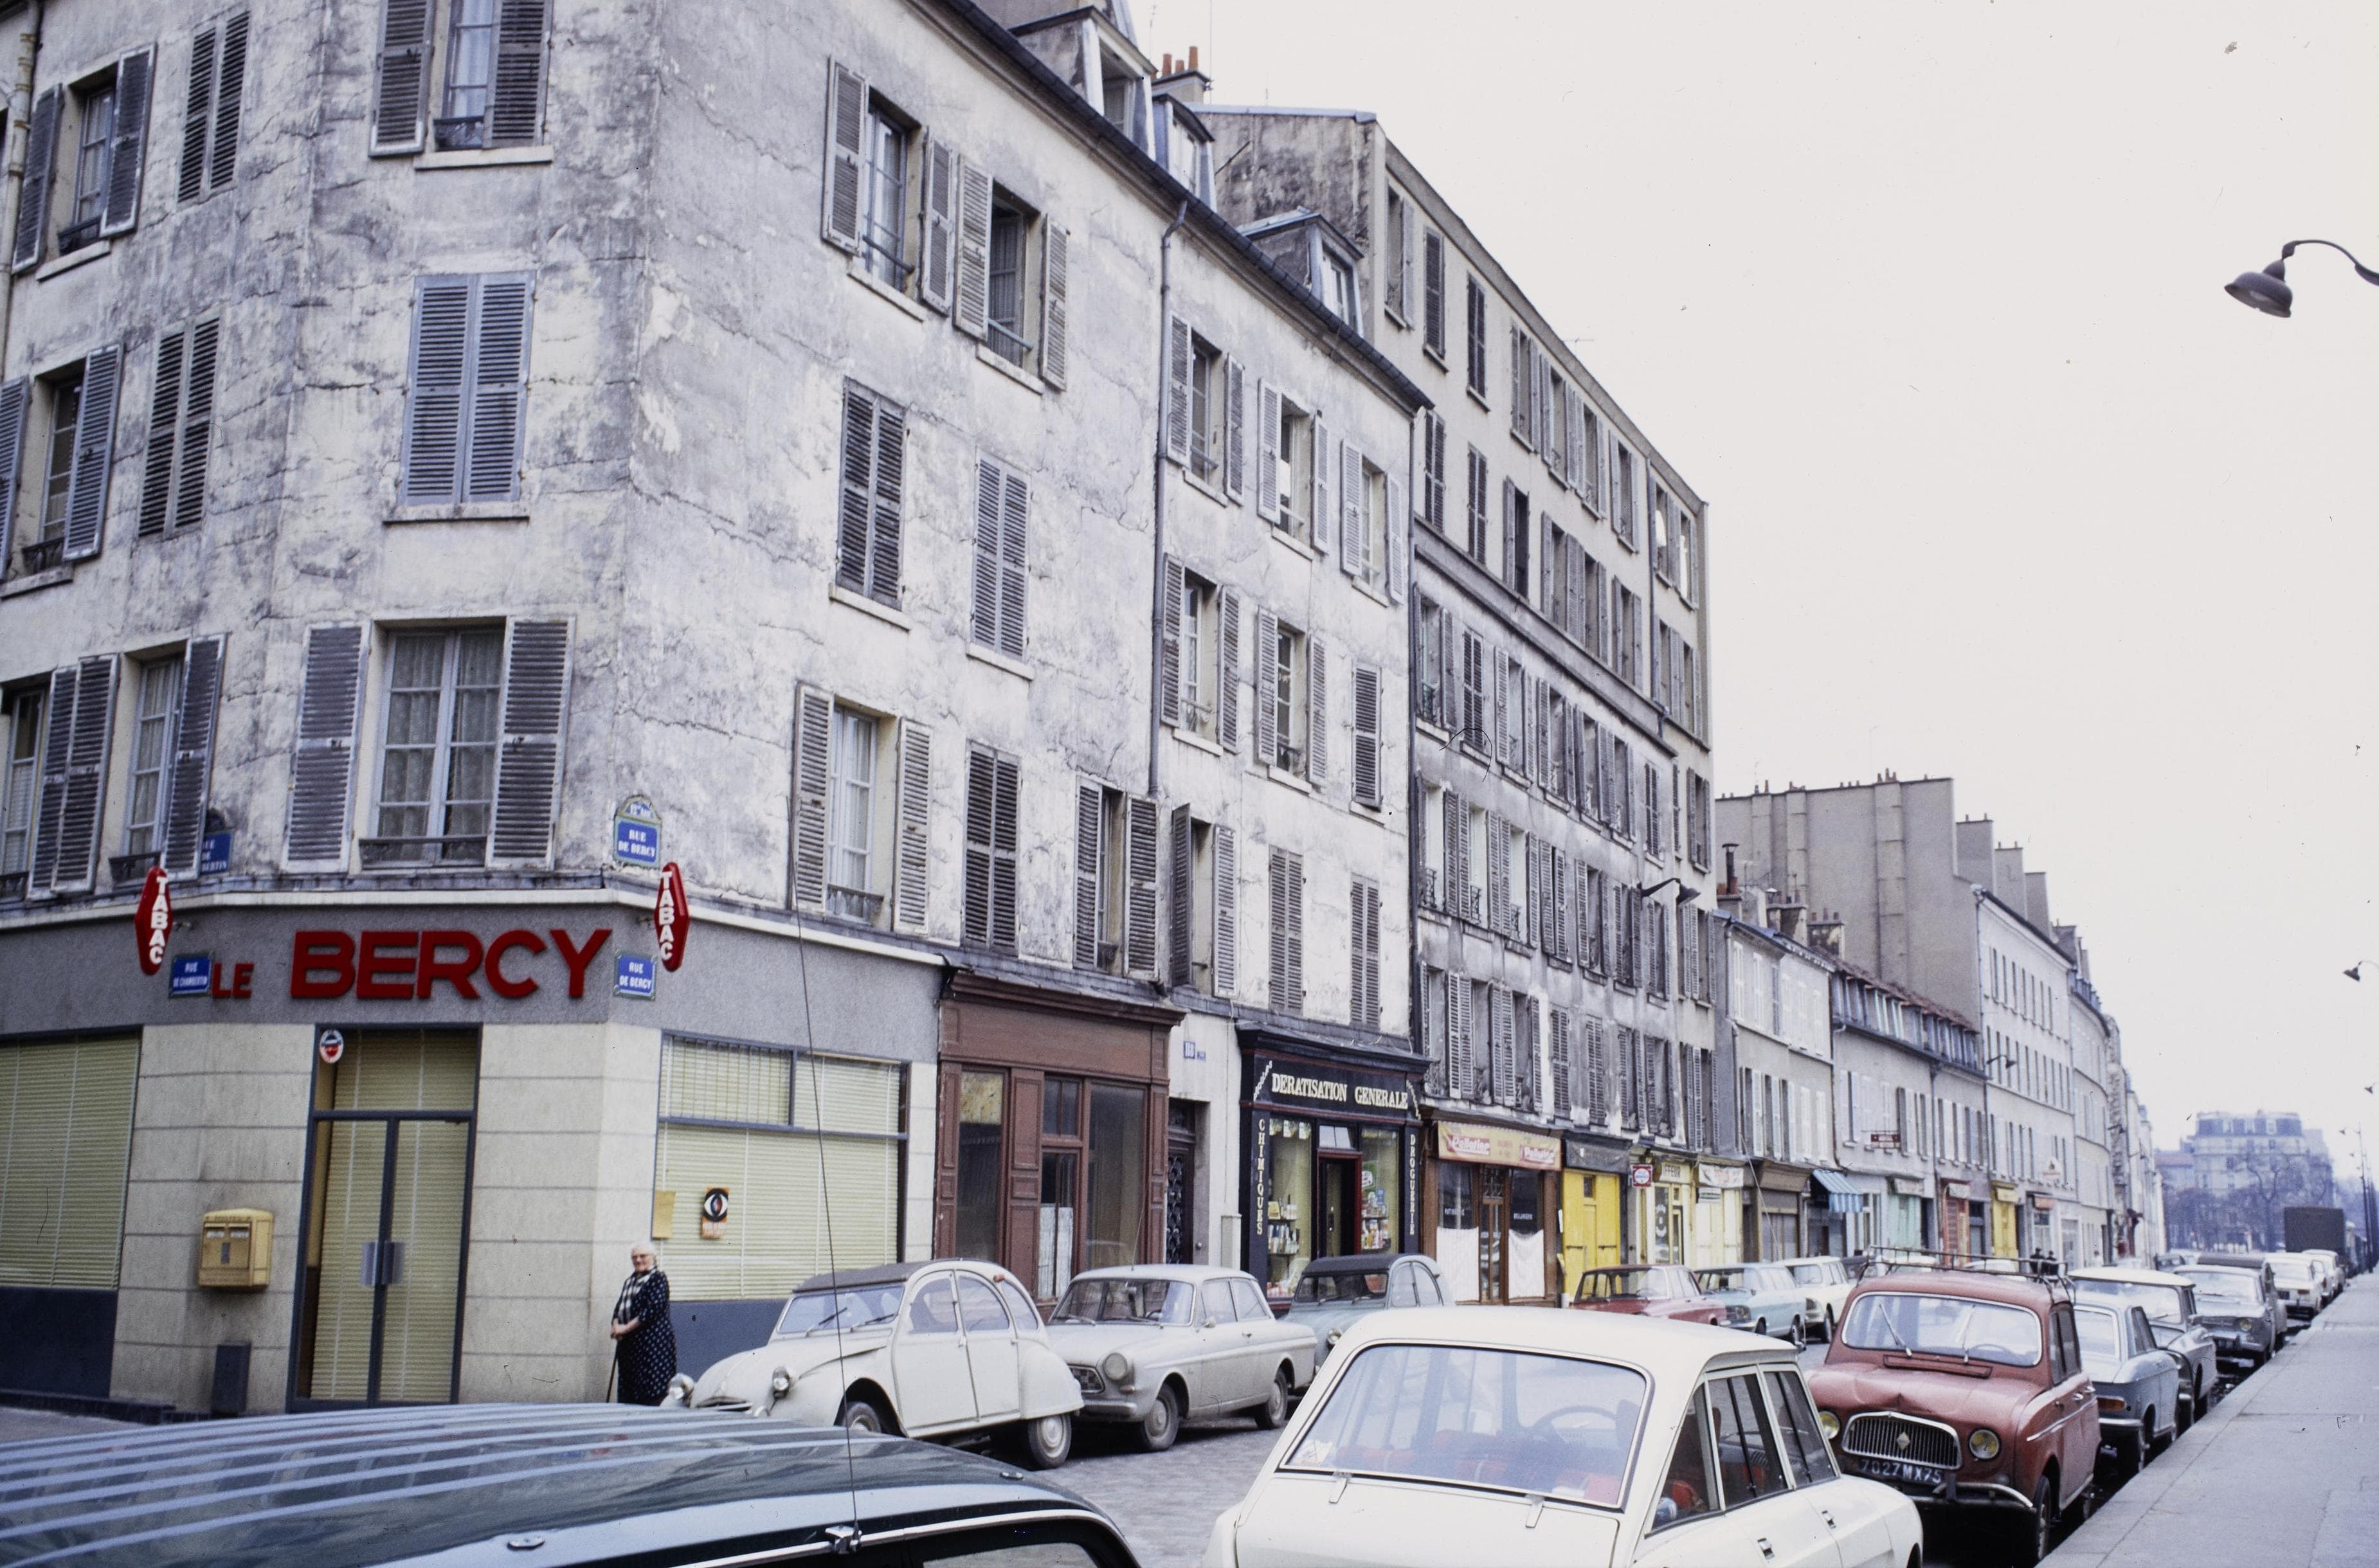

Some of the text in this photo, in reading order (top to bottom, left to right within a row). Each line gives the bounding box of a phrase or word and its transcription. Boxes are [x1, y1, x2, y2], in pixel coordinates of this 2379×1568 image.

[618, 840, 656, 858] DE BERCY
[629, 829, 646, 842] RUE
[149, 876, 168, 964] TABAC
[658, 871, 674, 961] TABAC
[185, 962, 198, 973] RUE
[213, 929, 613, 998] LE BERCY
[629, 962, 644, 974] RUE
[619, 975, 652, 989] DE BERCY
[1272, 1072, 1347, 1102] DERATISATION
[1354, 1086, 1408, 1110] GENERALE
[1256, 1119, 1265, 1235] CHIMIQUES
